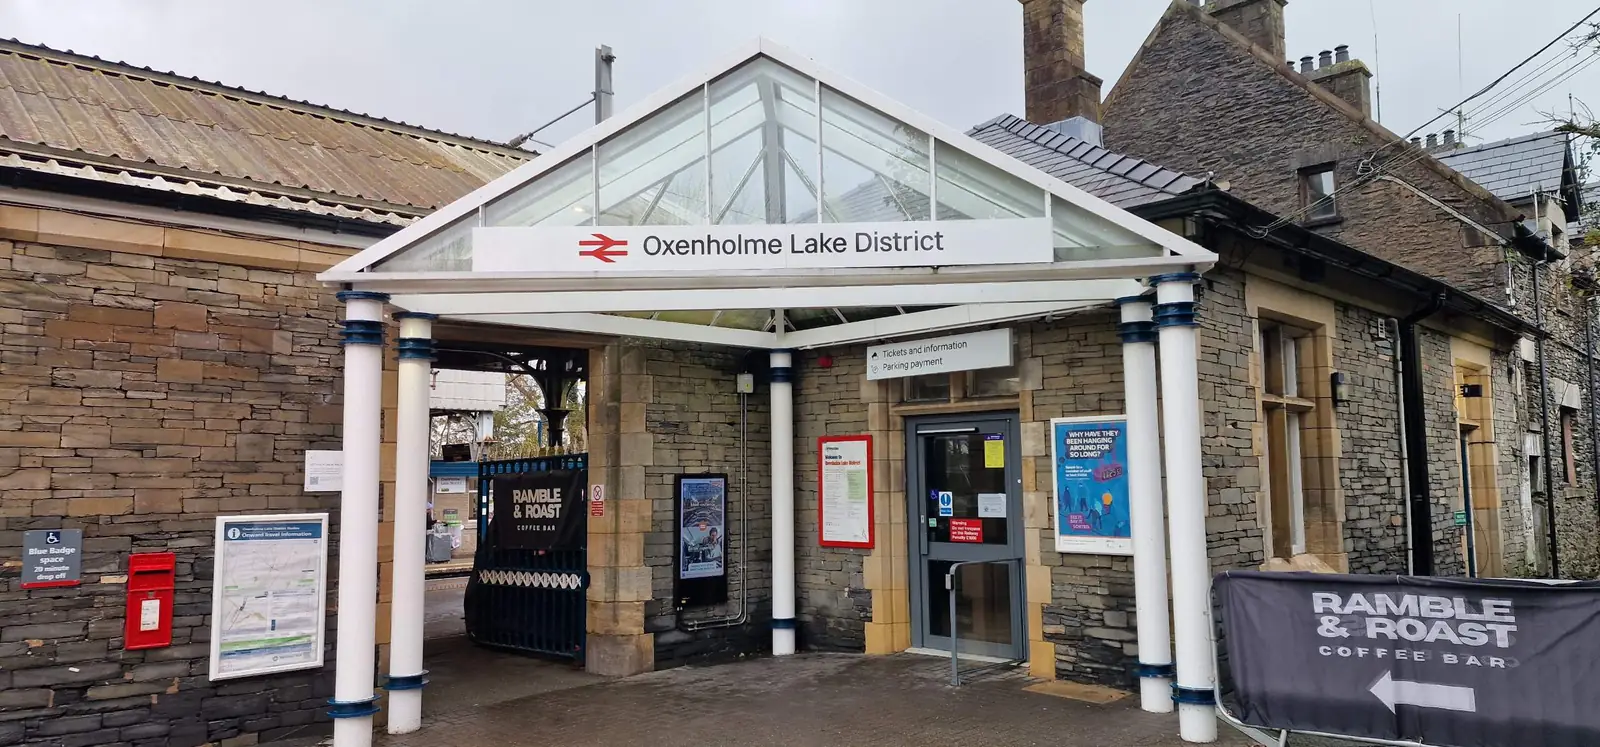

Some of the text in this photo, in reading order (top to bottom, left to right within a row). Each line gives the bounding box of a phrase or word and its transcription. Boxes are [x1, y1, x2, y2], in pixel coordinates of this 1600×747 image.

[643, 230, 944, 256] Oxenholme Lake District
[882, 340, 968, 358] Tickets and information
[883, 357, 943, 371] Parking payment
[513, 488, 561, 503] RAMBLE
[513, 503, 562, 518] & ROAST
[49, 547, 76, 555] Badge
[39, 556, 64, 564] space
[1312, 592, 1516, 623] RAMBLE
[1317, 615, 1518, 648] & ROAST
[1318, 645, 1506, 669] COFFEE BAR
